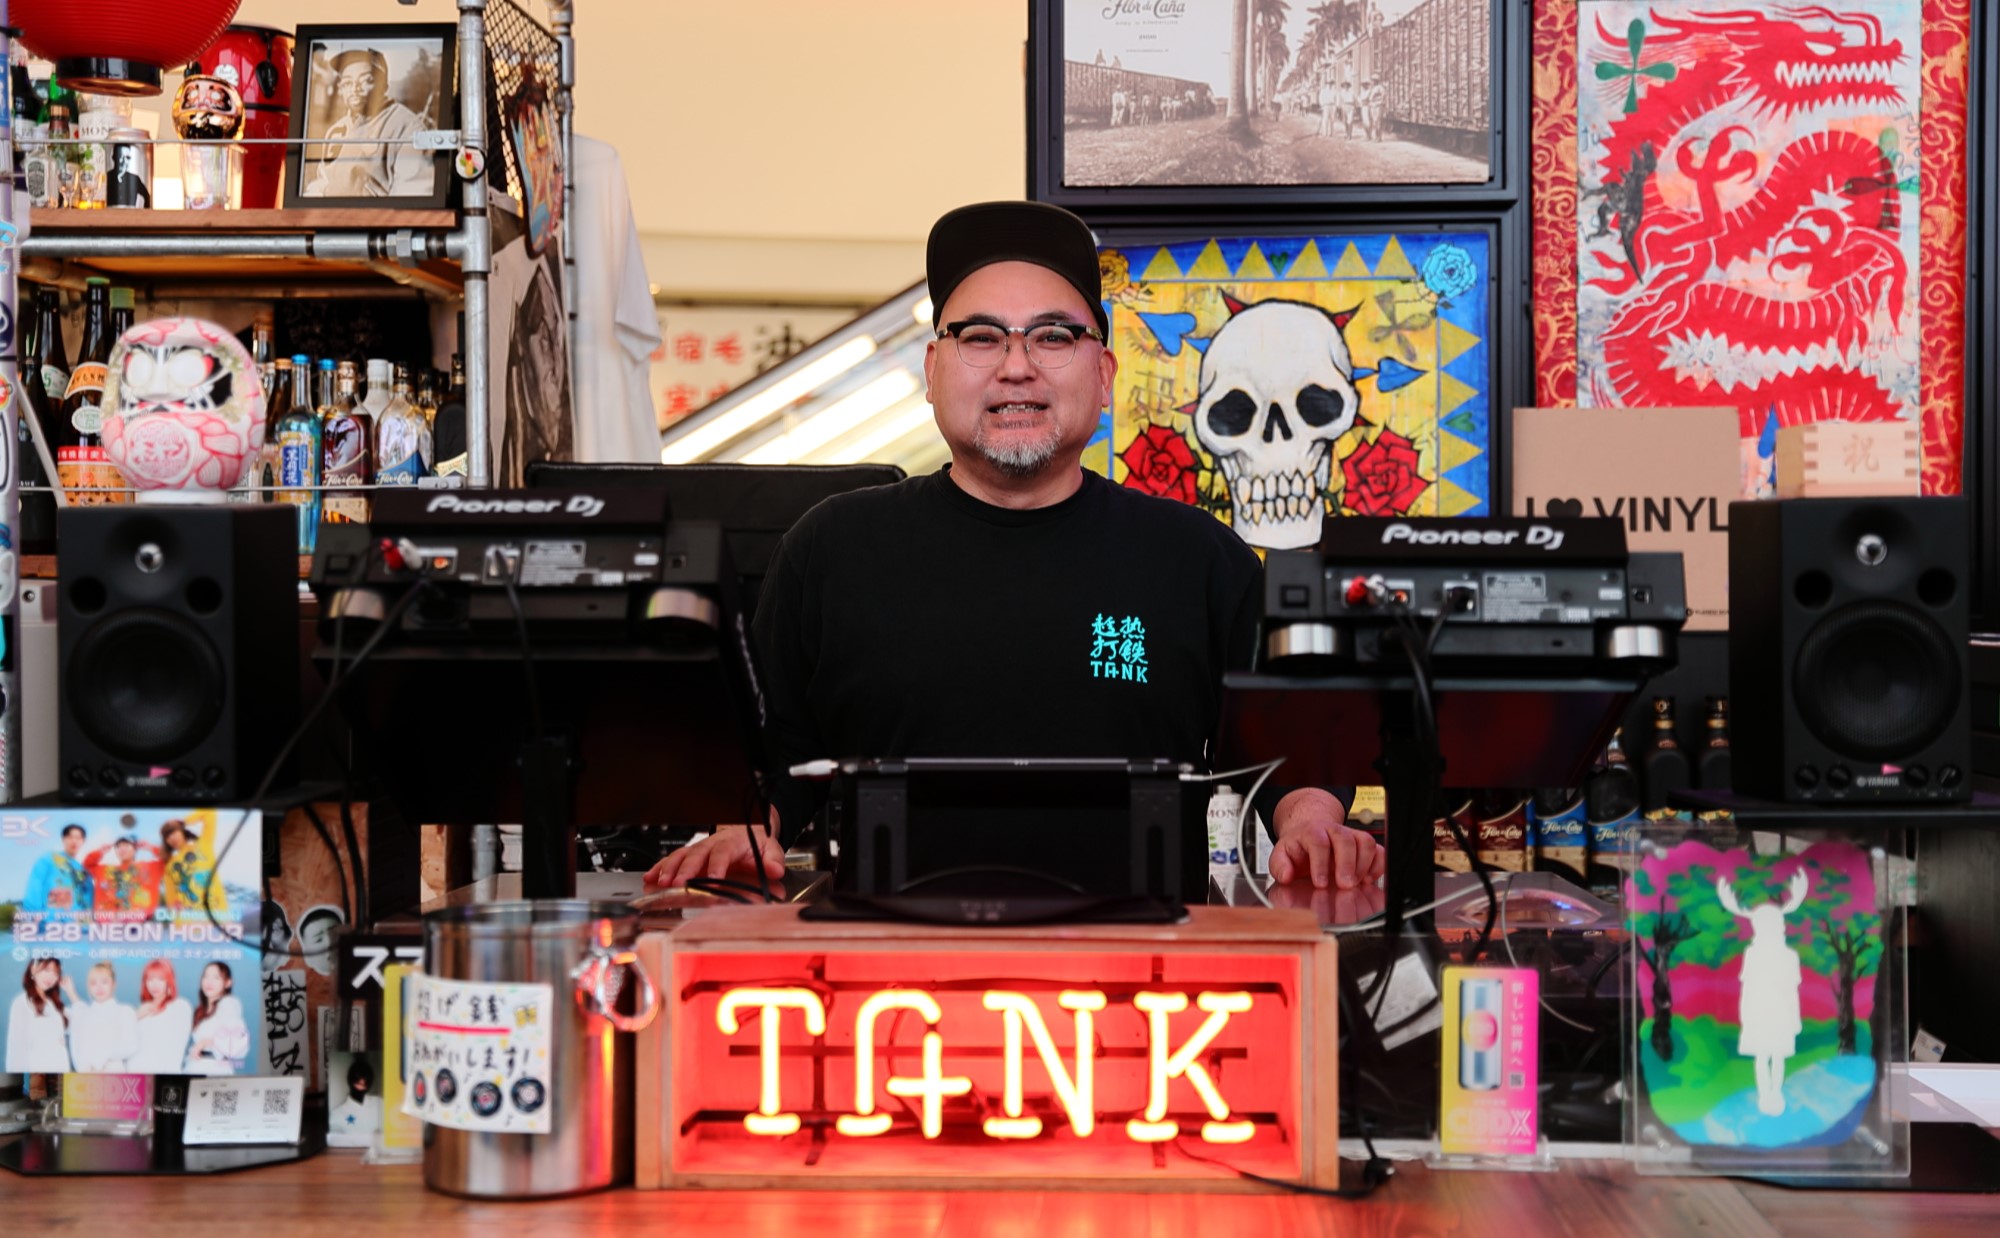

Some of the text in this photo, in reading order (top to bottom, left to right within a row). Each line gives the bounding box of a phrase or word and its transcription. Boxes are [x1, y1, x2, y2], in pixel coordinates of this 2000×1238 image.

[1843, 433, 1880, 474] 祝
[427, 494, 561, 513] Pioneer
[1593, 497, 1730, 532] VINYL
[1381, 523, 1518, 545] Pioneer
[1090, 660, 1148, 684] TANK
[1867, 776, 1899, 787] YAMAHA
[89, 923, 161, 942] NEON
[169, 923, 244, 942] HOUR
[716, 987, 1256, 1143] TANK
